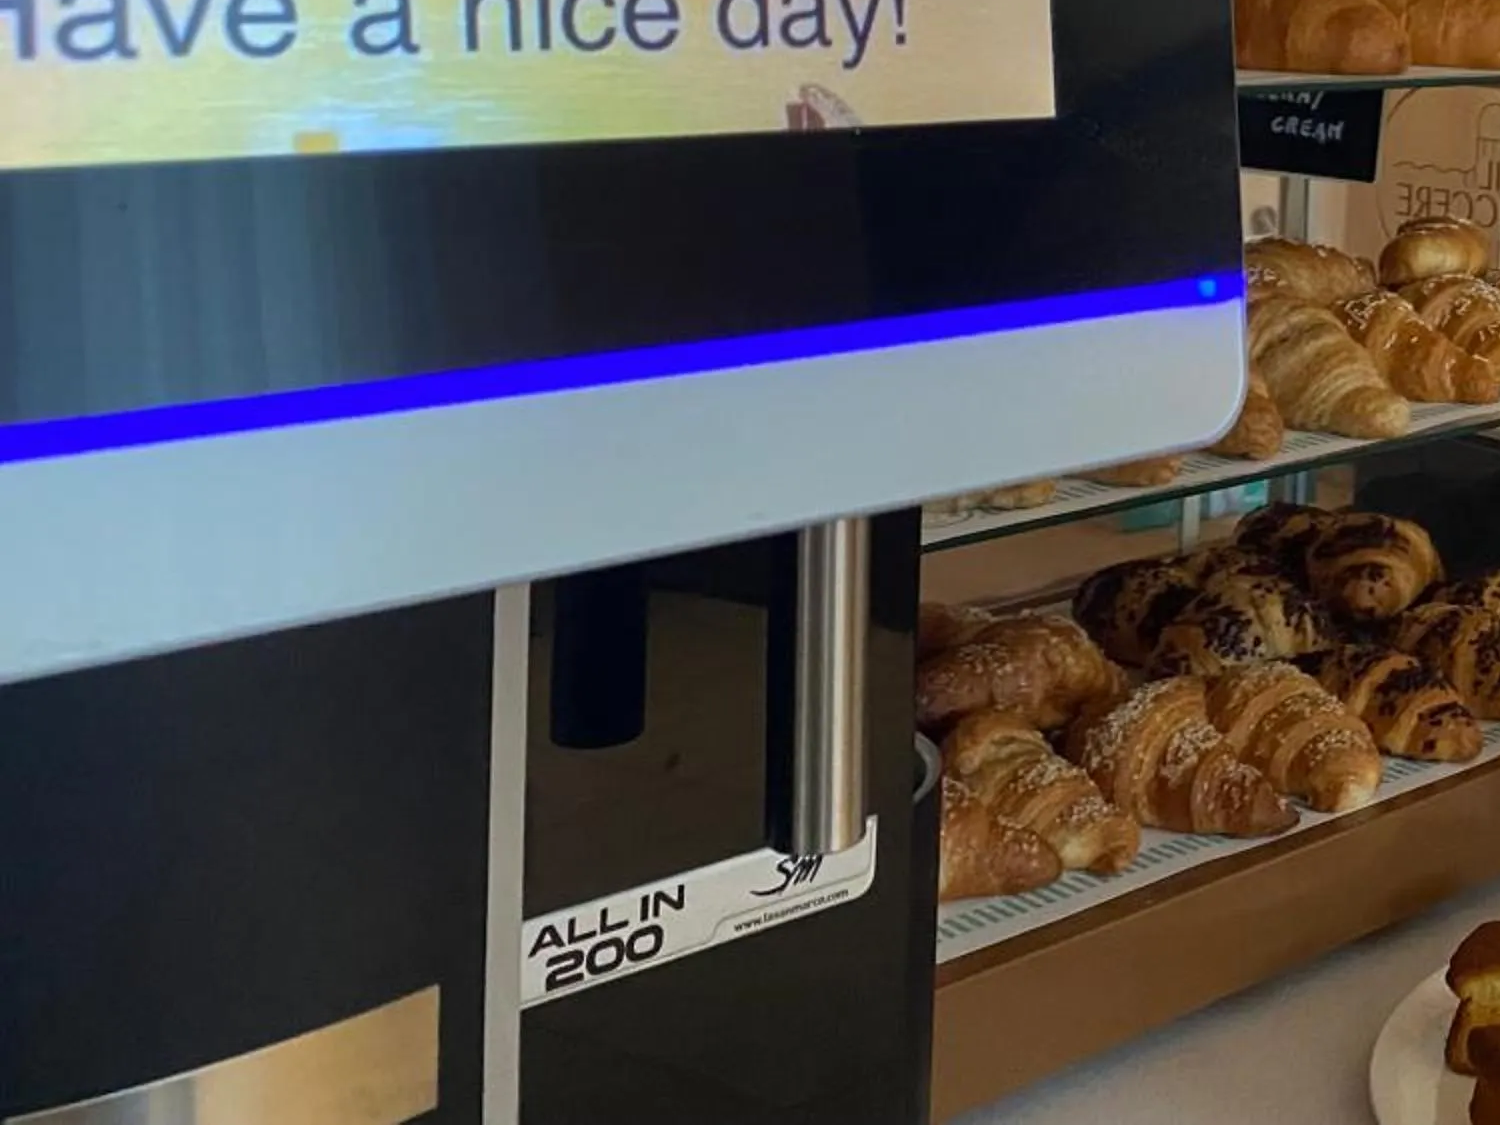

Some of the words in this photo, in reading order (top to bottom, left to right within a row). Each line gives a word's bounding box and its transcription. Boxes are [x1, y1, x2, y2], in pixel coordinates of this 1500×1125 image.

[1270, 116, 1345, 144] CREAM
[528, 906, 629, 958] ALL
[639, 884, 686, 922] IN
[545, 924, 664, 993] 200
